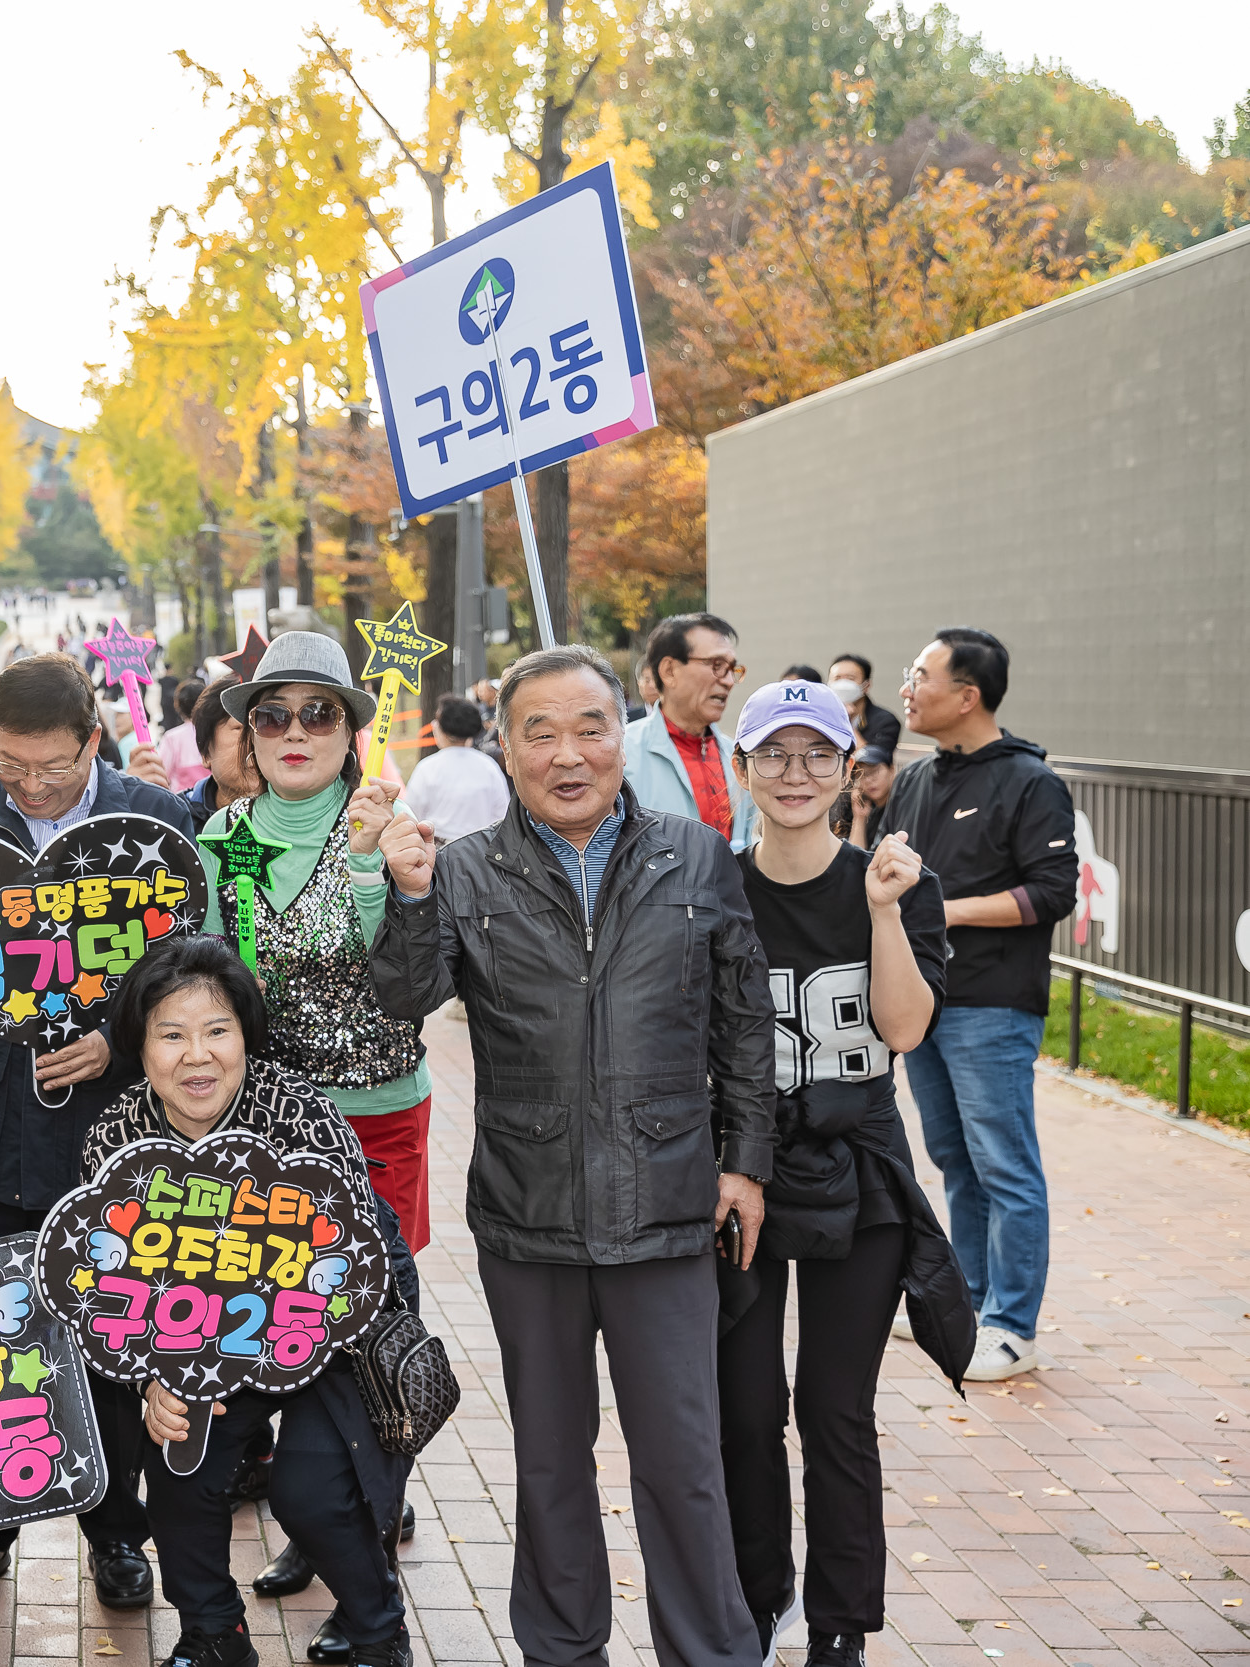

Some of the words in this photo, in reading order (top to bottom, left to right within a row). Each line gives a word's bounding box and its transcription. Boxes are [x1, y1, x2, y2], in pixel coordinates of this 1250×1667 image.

[415, 320, 603, 465] 구의2동
[378, 646, 419, 670] 김기덕
[783, 687, 809, 702] M
[223, 842, 264, 856] 빛이나는
[228, 853, 260, 866] 구의2동
[228, 864, 261, 877] 화이팅
[36, 868, 188, 922] 명품가수
[146, 1169, 315, 1226] 슈퍼스타
[129, 1222, 314, 1288] 우주최강
[92, 1276, 327, 1366] 구의2동
